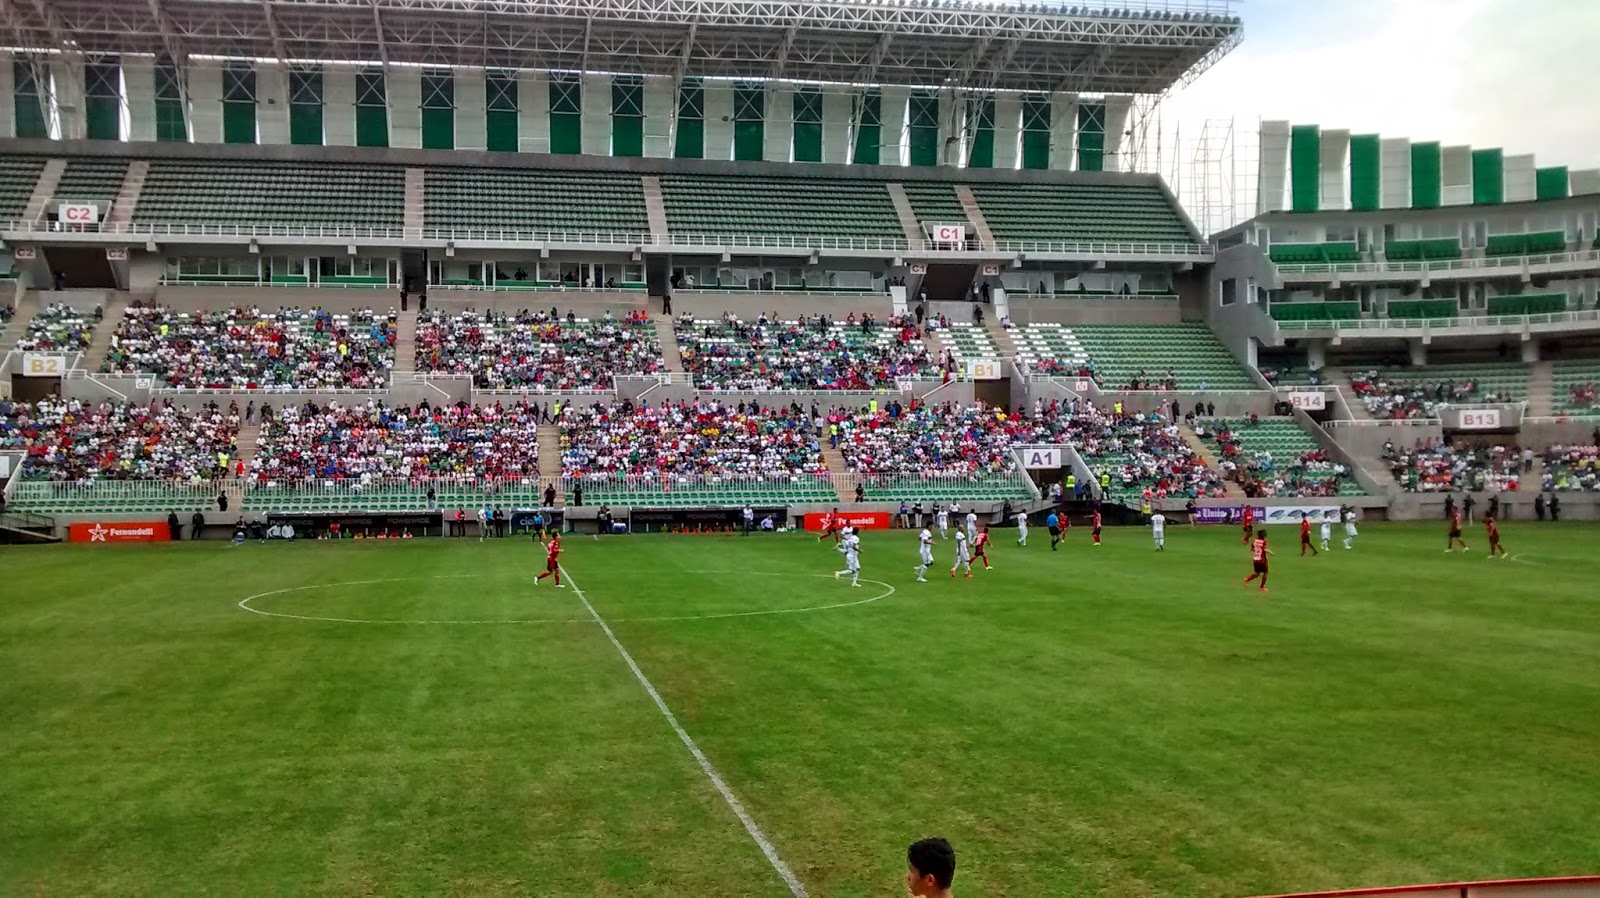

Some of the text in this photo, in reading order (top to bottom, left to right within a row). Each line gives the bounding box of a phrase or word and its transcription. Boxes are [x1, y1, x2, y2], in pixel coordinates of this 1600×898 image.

[66, 206, 91, 220] C2
[939, 227, 959, 240] C1
[16, 248, 34, 257] C2
[107, 249, 125, 258] C2
[911, 264, 925, 273] C1
[984, 265, 998, 274] C1
[31, 359, 58, 373] B2
[974, 364, 994, 377] B1
[1292, 396, 1321, 407] B14
[1464, 414, 1495, 425] B13
[1030, 451, 1053, 466] A1
[110, 527, 154, 537] Fernandelli
